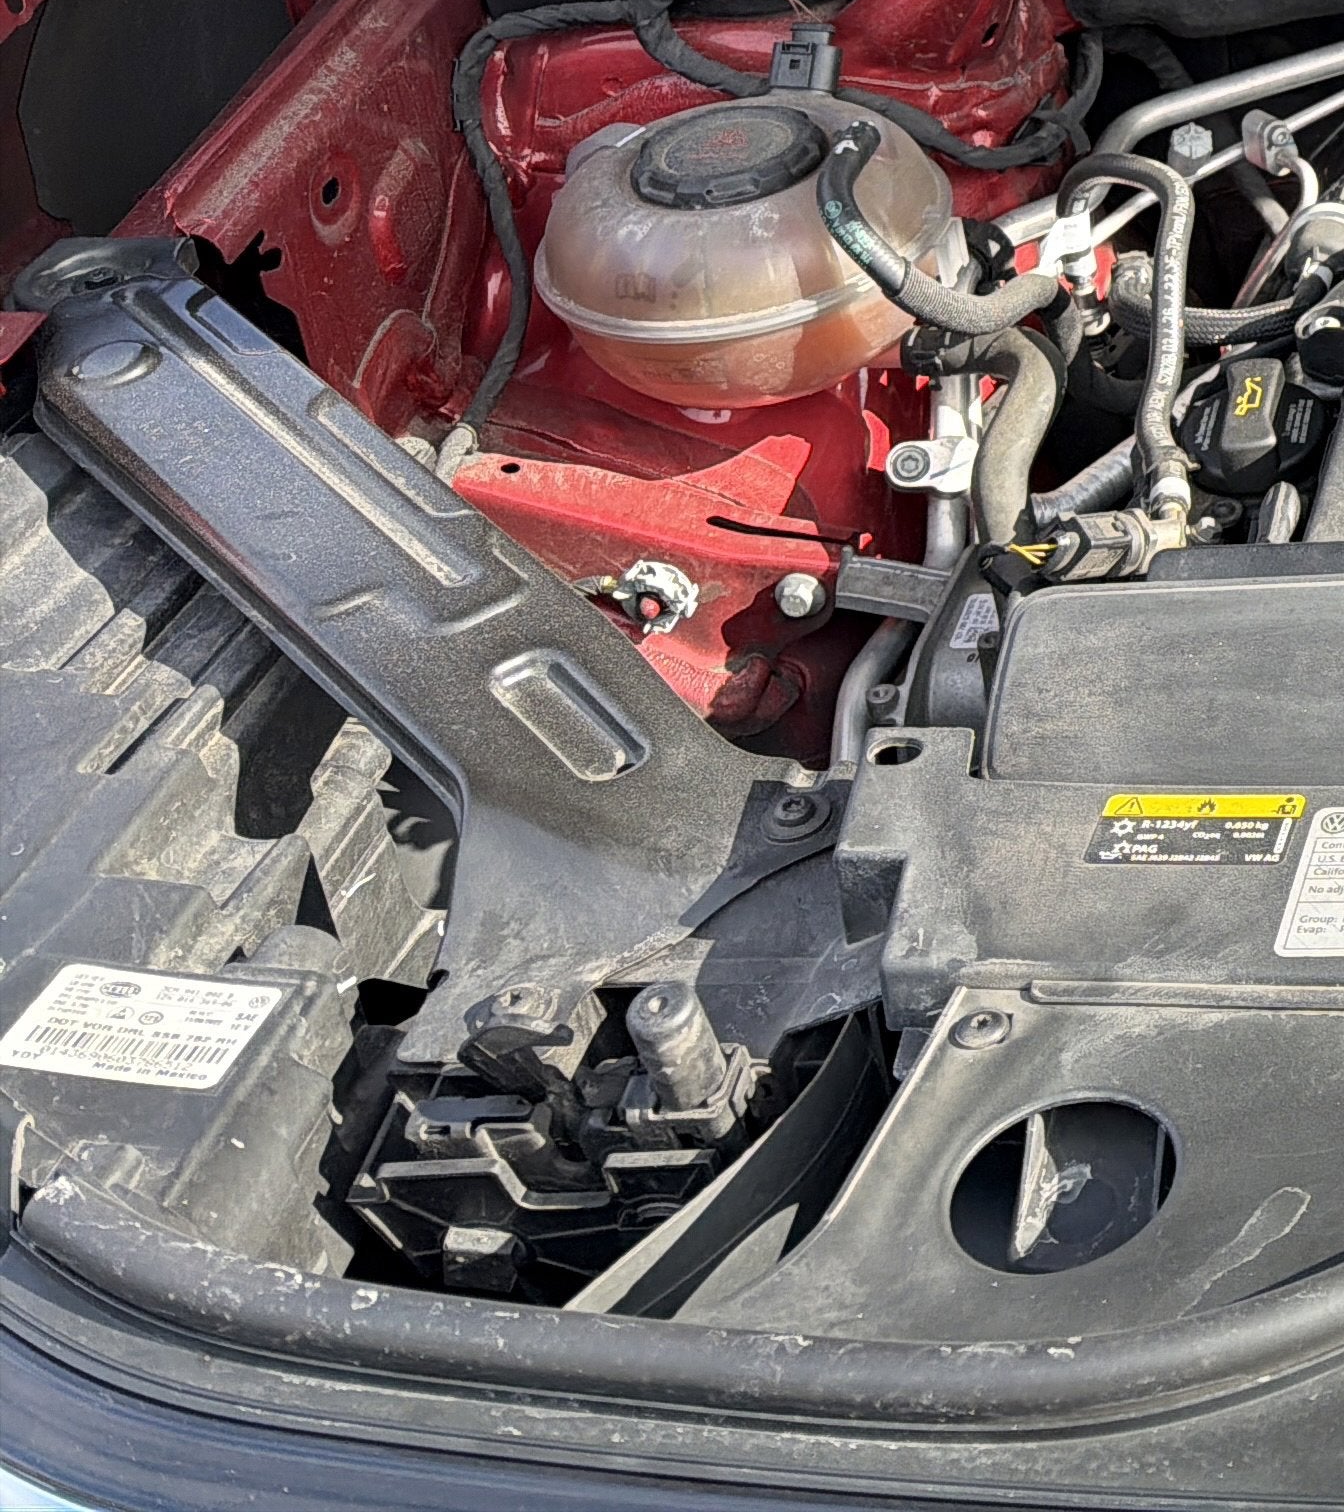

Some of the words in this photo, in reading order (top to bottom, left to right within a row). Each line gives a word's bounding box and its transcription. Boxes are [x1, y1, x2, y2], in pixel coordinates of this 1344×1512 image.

[1141, 819, 1199, 831] R-1234yf
[1132, 844, 1158, 853] PAG
[1244, 854, 1262, 862] VW
[1263, 854, 1280, 862] AG
[1308, 886, 1325, 894] No
[1299, 914, 1338, 926] Group:
[1297, 925, 1326, 935] Evap:
[48, 1017, 79, 1026] DOT
[92, 1061, 131, 1072] Made
[136, 1067, 151, 1075] in
[155, 1069, 207, 1080] Mexico
